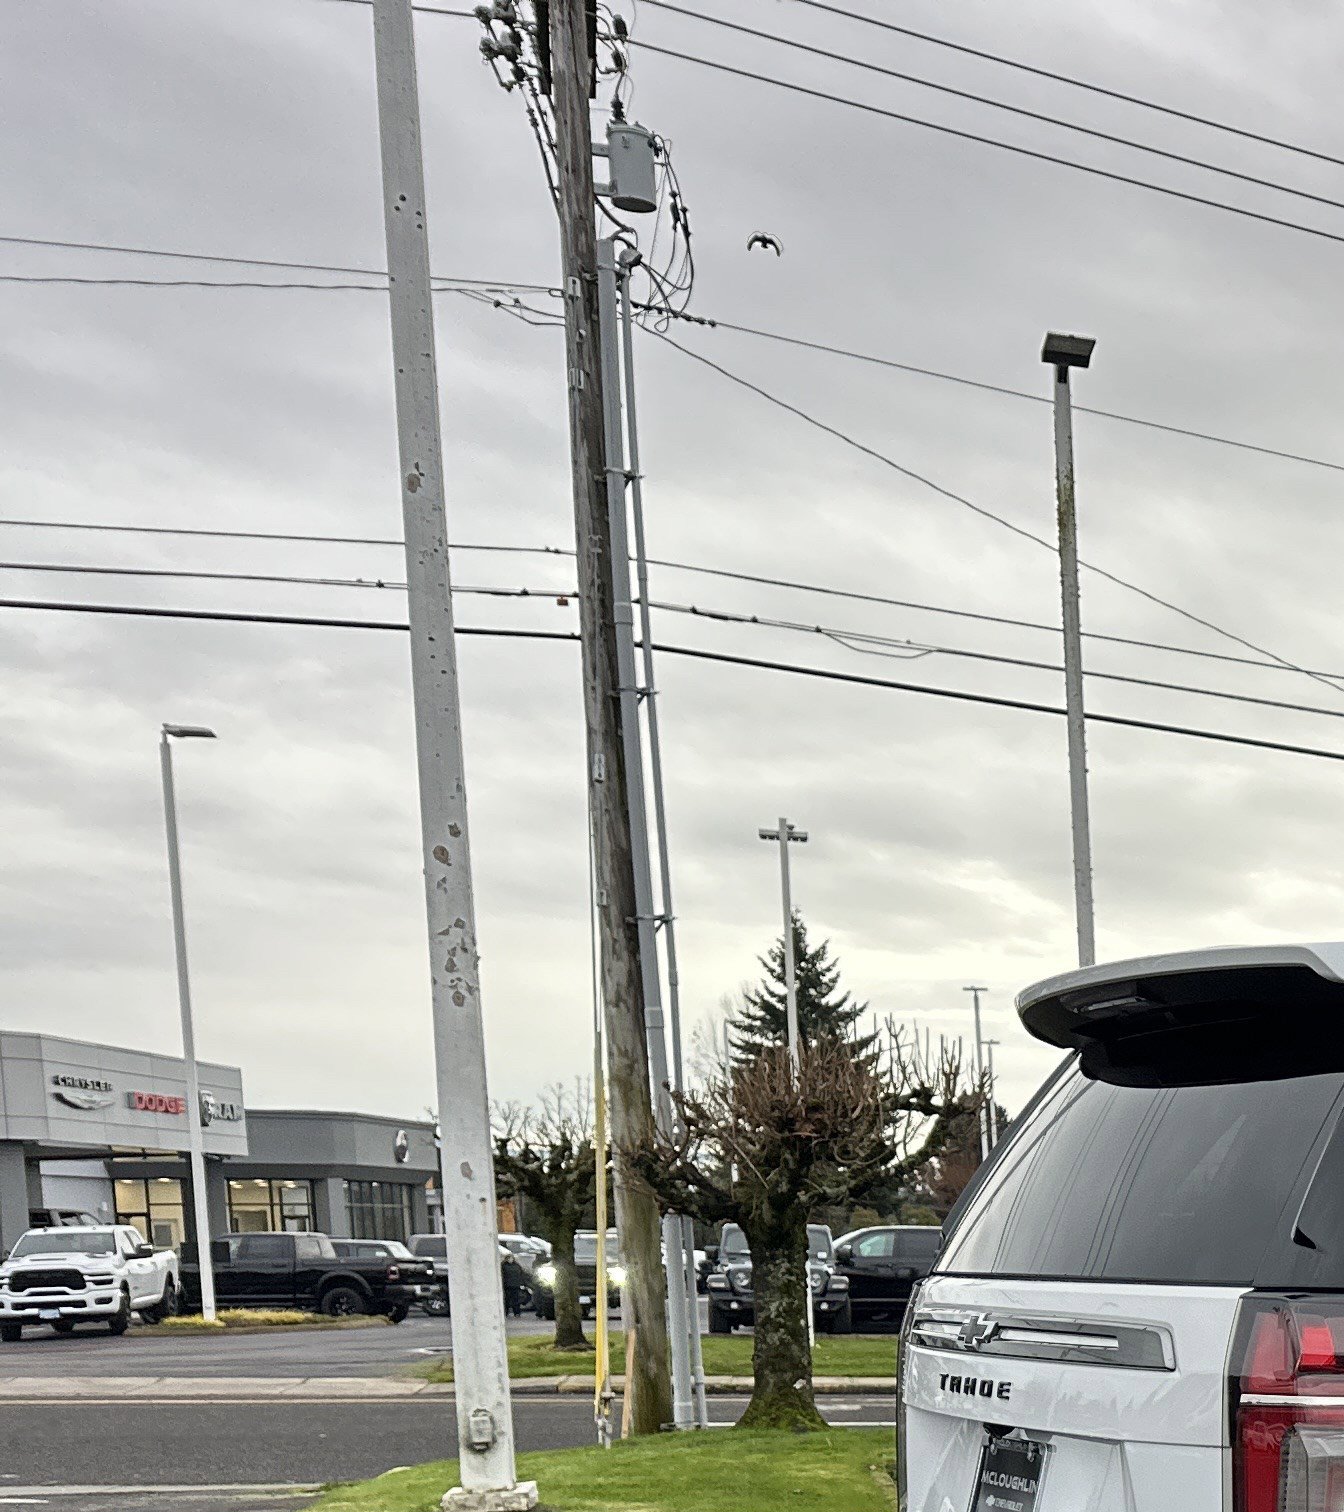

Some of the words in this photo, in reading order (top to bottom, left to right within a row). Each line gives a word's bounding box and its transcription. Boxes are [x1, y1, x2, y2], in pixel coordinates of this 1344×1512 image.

[133, 1091, 187, 1114] DODGE
[940, 1373, 1012, 1400] TAHOE
[980, 1469, 1039, 1494] MCLOUGHLIN
